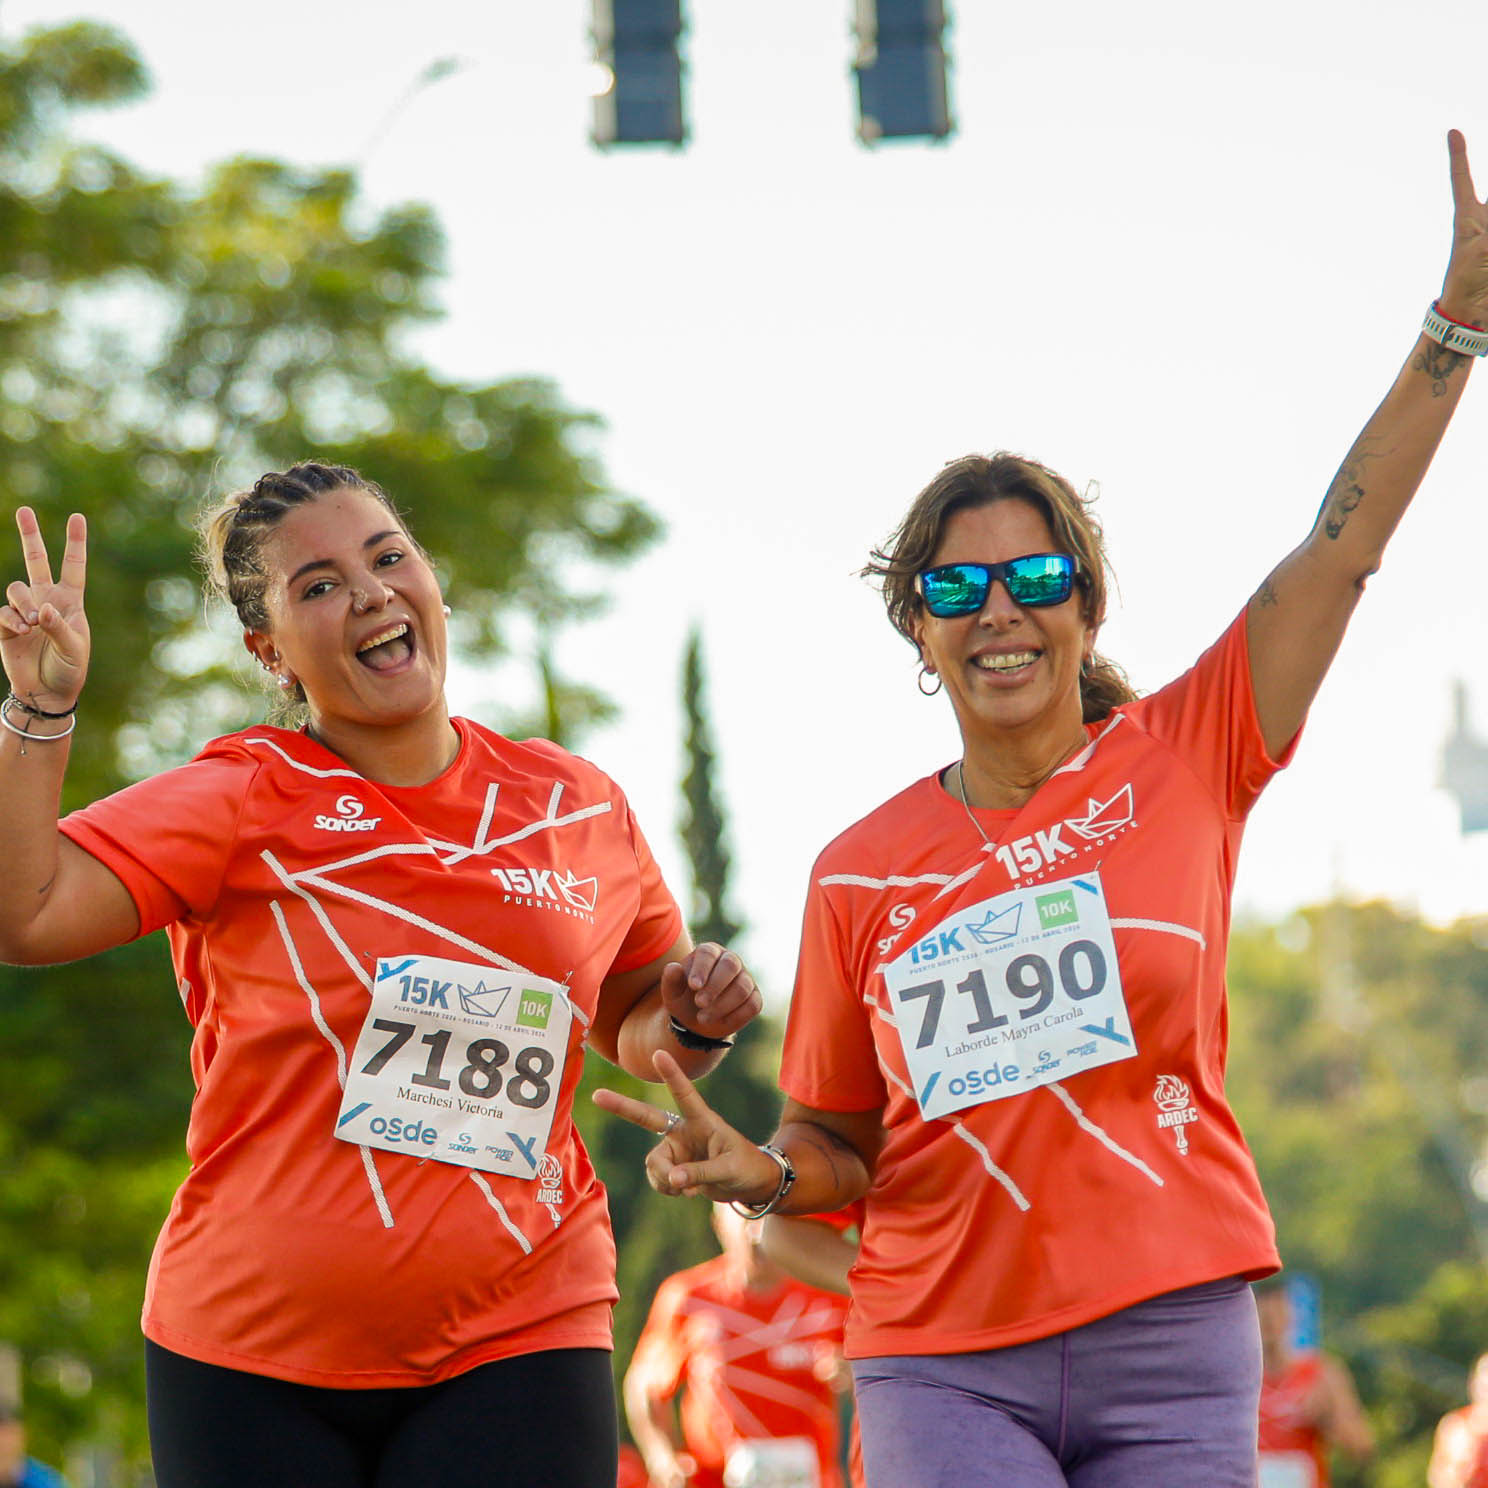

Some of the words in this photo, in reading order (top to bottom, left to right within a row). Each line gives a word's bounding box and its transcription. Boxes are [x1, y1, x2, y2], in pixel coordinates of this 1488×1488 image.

[995, 823, 1075, 880] 15K
[491, 868, 558, 900] 15K
[504, 895, 560, 912] PUERTO
[1041, 898, 1073, 919] 10K
[908, 926, 966, 965] 15K
[399, 975, 453, 1010] 15K
[898, 939, 1108, 1050] 7190
[521, 1000, 547, 1018] 10K
[945, 1035, 999, 1058] Laborde
[1001, 1024, 1041, 1043] Mayra
[1043, 1006, 1084, 1028] Carola
[360, 1018, 555, 1109] 7188
[948, 1061, 1020, 1096] osde
[397, 1087, 453, 1109] Marchesi
[457, 1099, 504, 1119] Victoria
[1157, 1107, 1199, 1129] ARDEC
[370, 1117, 438, 1146] osde
[536, 1189, 563, 1204] ARDEC
